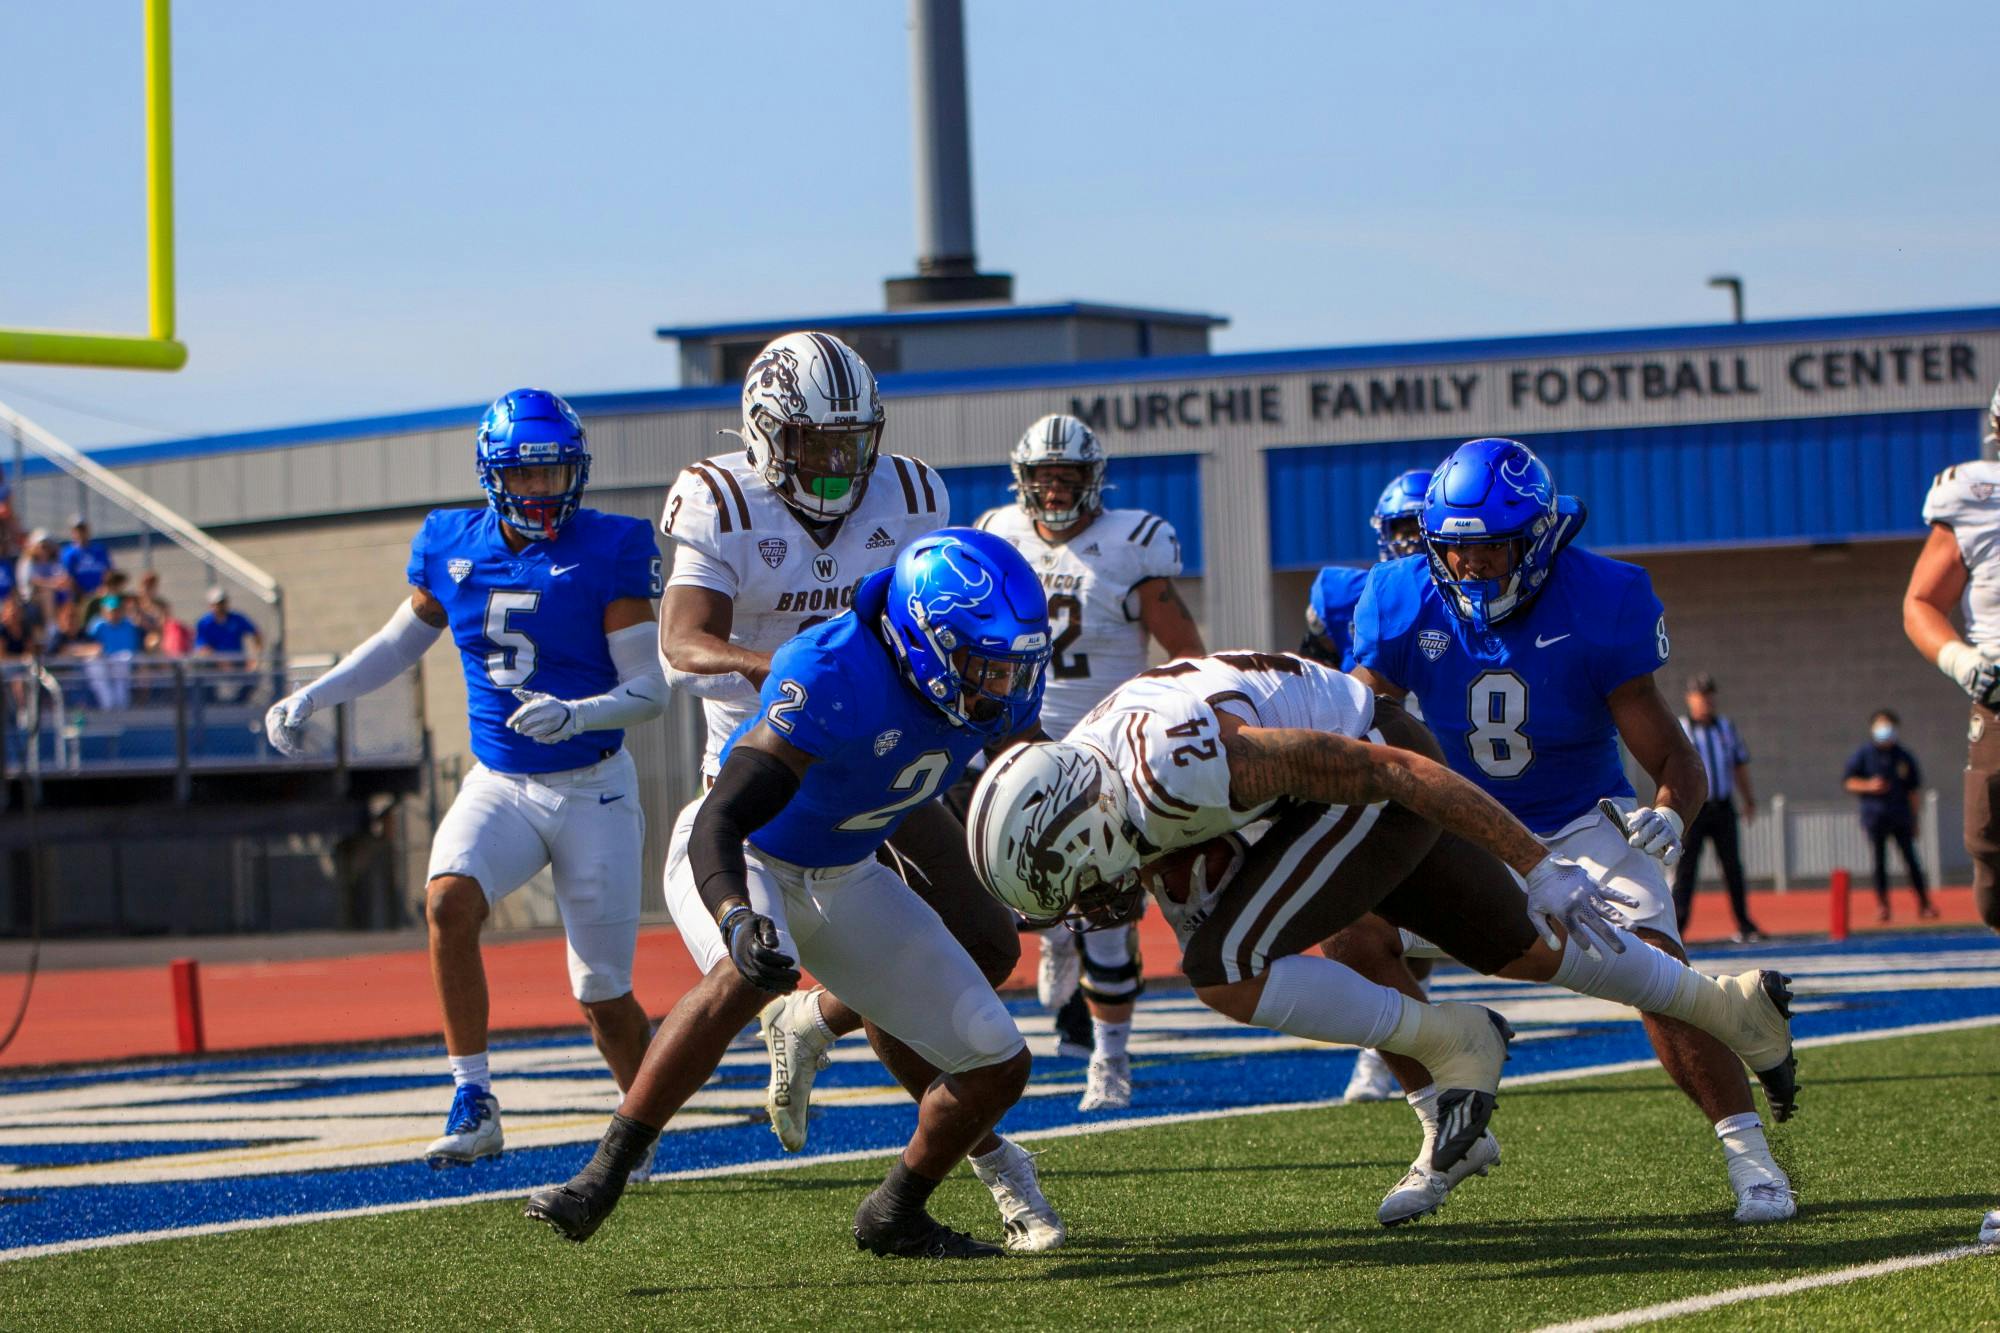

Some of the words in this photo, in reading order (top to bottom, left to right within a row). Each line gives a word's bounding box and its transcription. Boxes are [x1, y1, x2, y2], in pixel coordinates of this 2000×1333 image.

[1071, 384, 1280, 431] MURCHIE
[1308, 374, 1480, 419] FAMILY
[1509, 356, 1758, 407] FOOTBALL
[1788, 344, 1978, 392] CENTER
[759, 547, 787, 556] MAC
[816, 559, 833, 578] W
[865, 538, 896, 550] adidas
[649, 556, 663, 598] 5
[481, 588, 541, 689] 5
[1047, 593, 1092, 679] 2
[1419, 640, 1448, 649] MAC
[1655, 615, 1670, 663] 8
[767, 680, 808, 734] 2
[1465, 668, 1536, 780] 8
[1165, 717, 1218, 768] 24
[832, 748, 953, 832] 2
[773, 1024, 791, 1107] ADIZERO
